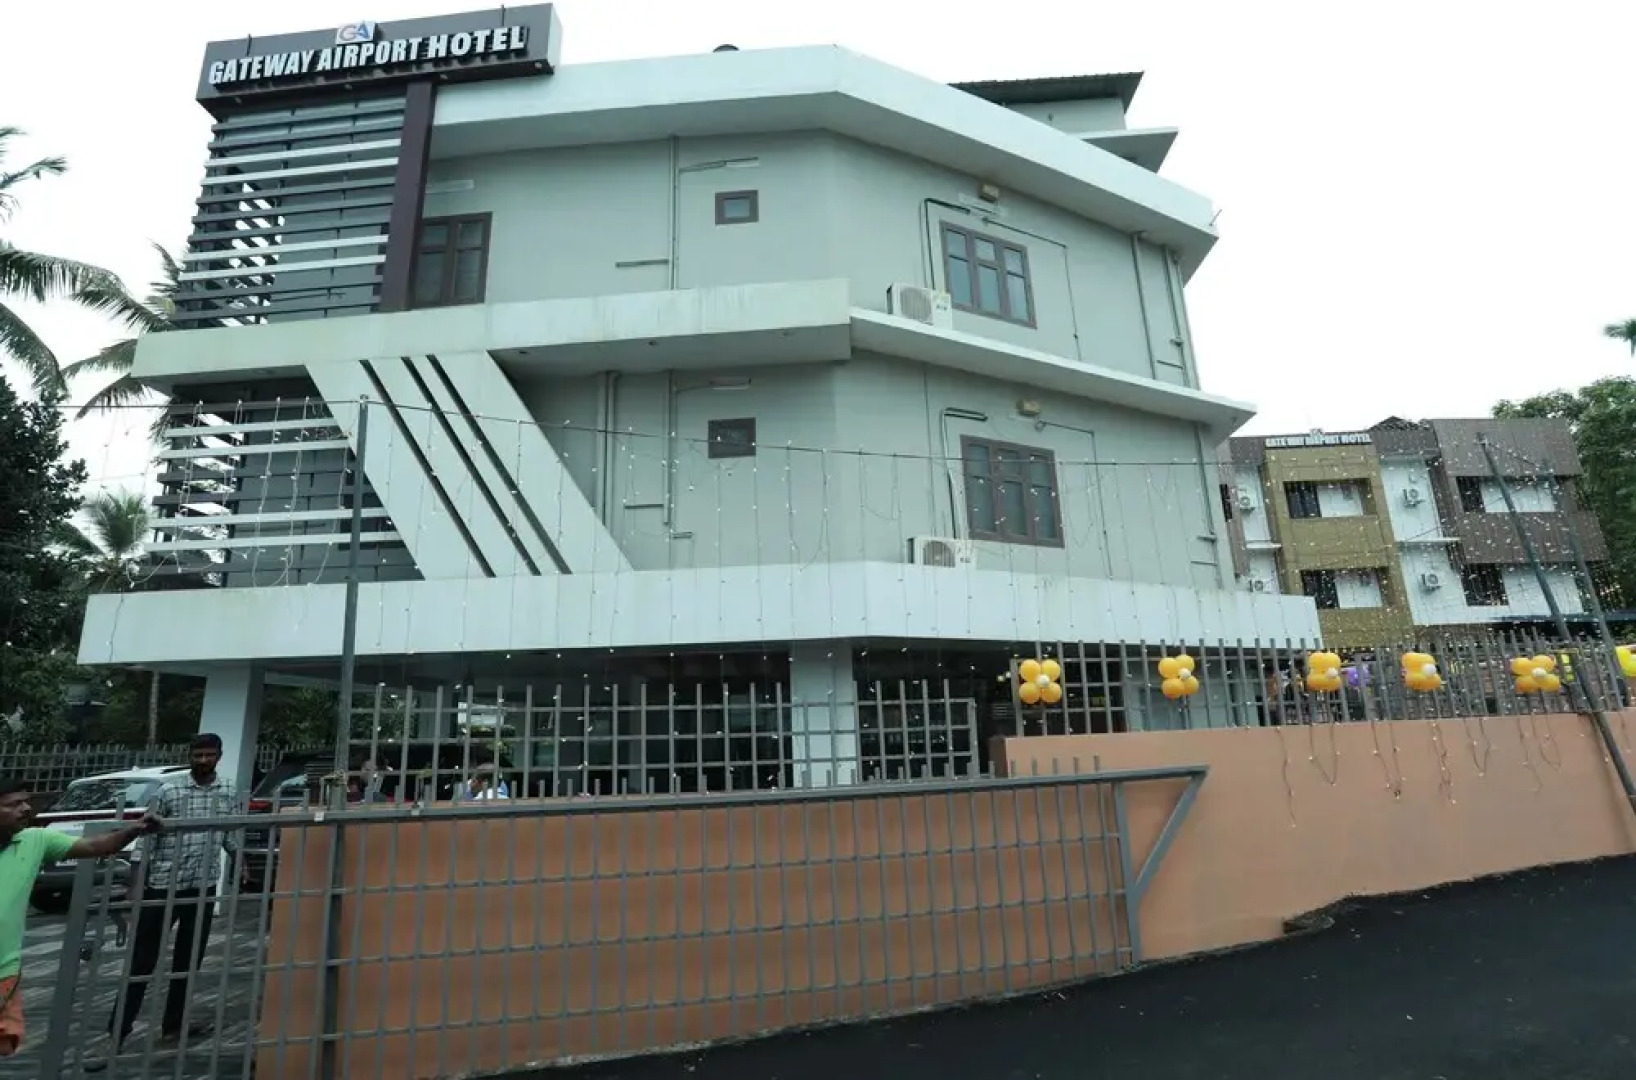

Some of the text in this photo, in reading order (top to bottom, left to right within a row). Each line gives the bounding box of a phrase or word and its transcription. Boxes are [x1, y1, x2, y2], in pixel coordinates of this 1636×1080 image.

[209, 25, 525, 84] GATEWAY AIRPORT HOTEL
